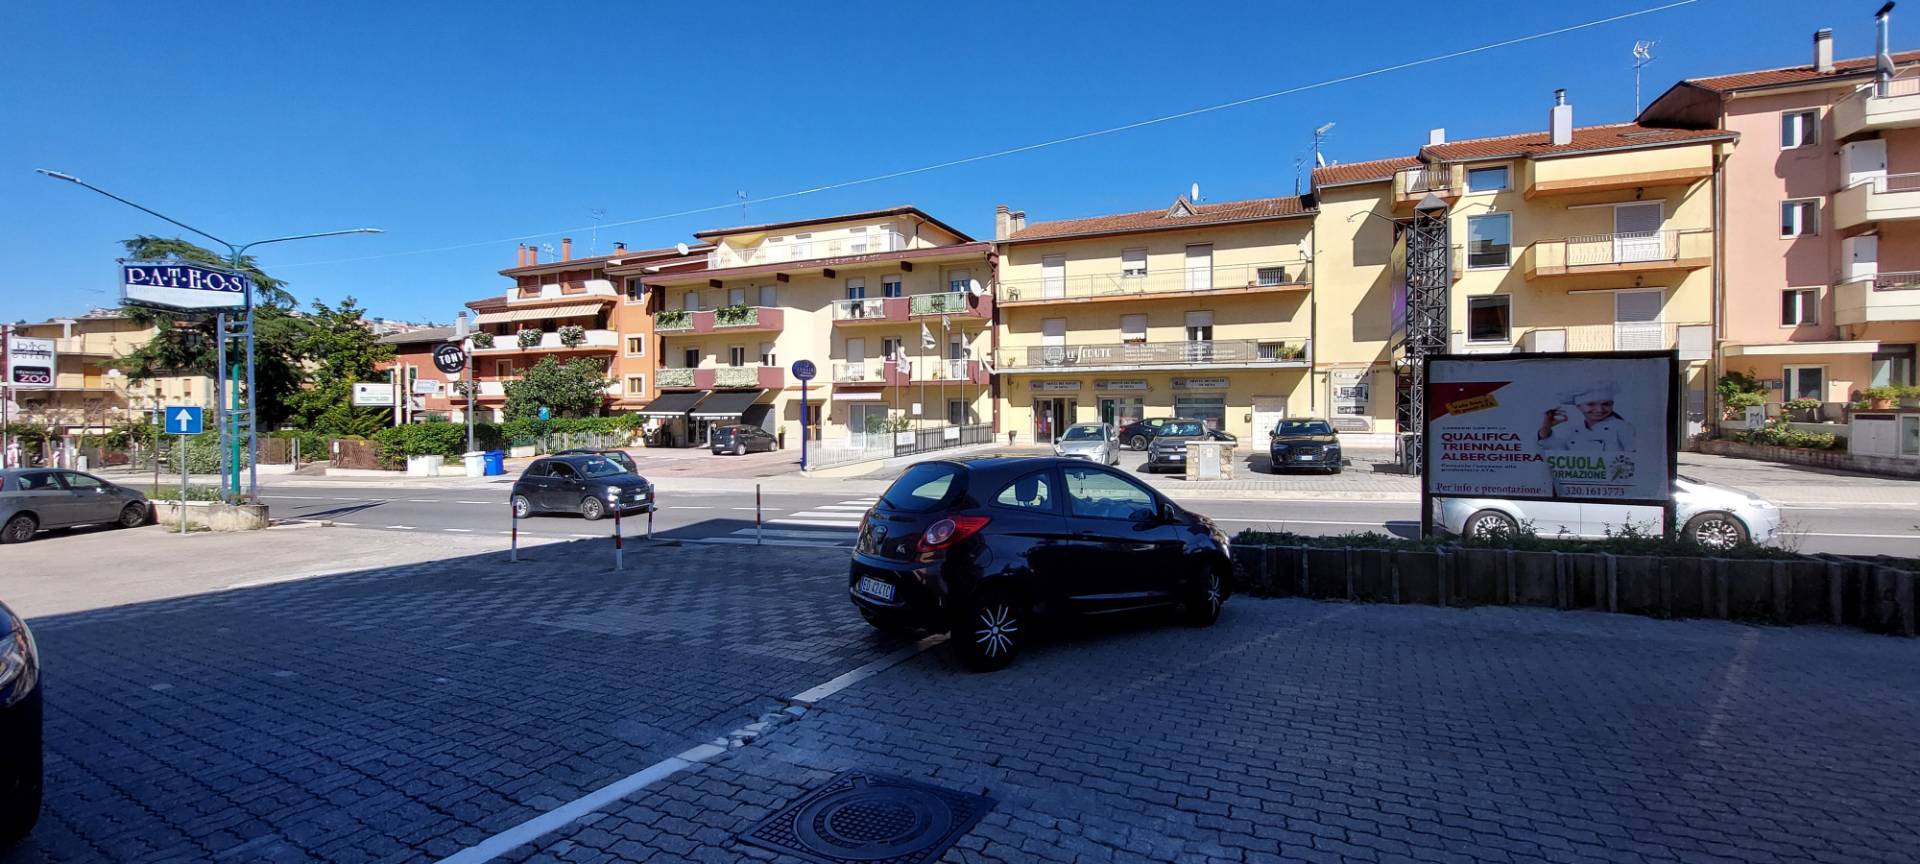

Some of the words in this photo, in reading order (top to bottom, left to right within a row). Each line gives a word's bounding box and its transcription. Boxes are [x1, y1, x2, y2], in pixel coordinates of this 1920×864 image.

[438, 351, 463, 365] TONY
[1441, 432, 1521, 442] QUALIFICA
[1441, 442, 1522, 452] TRIENNALE
[1440, 452, 1544, 462] ALBERGHIERA
[1547, 456, 1606, 470] SCUOLA
[1551, 470, 1607, 480] ORMAZIONE
[1437, 482, 1450, 492] Per
[1454, 482, 1472, 493] info
